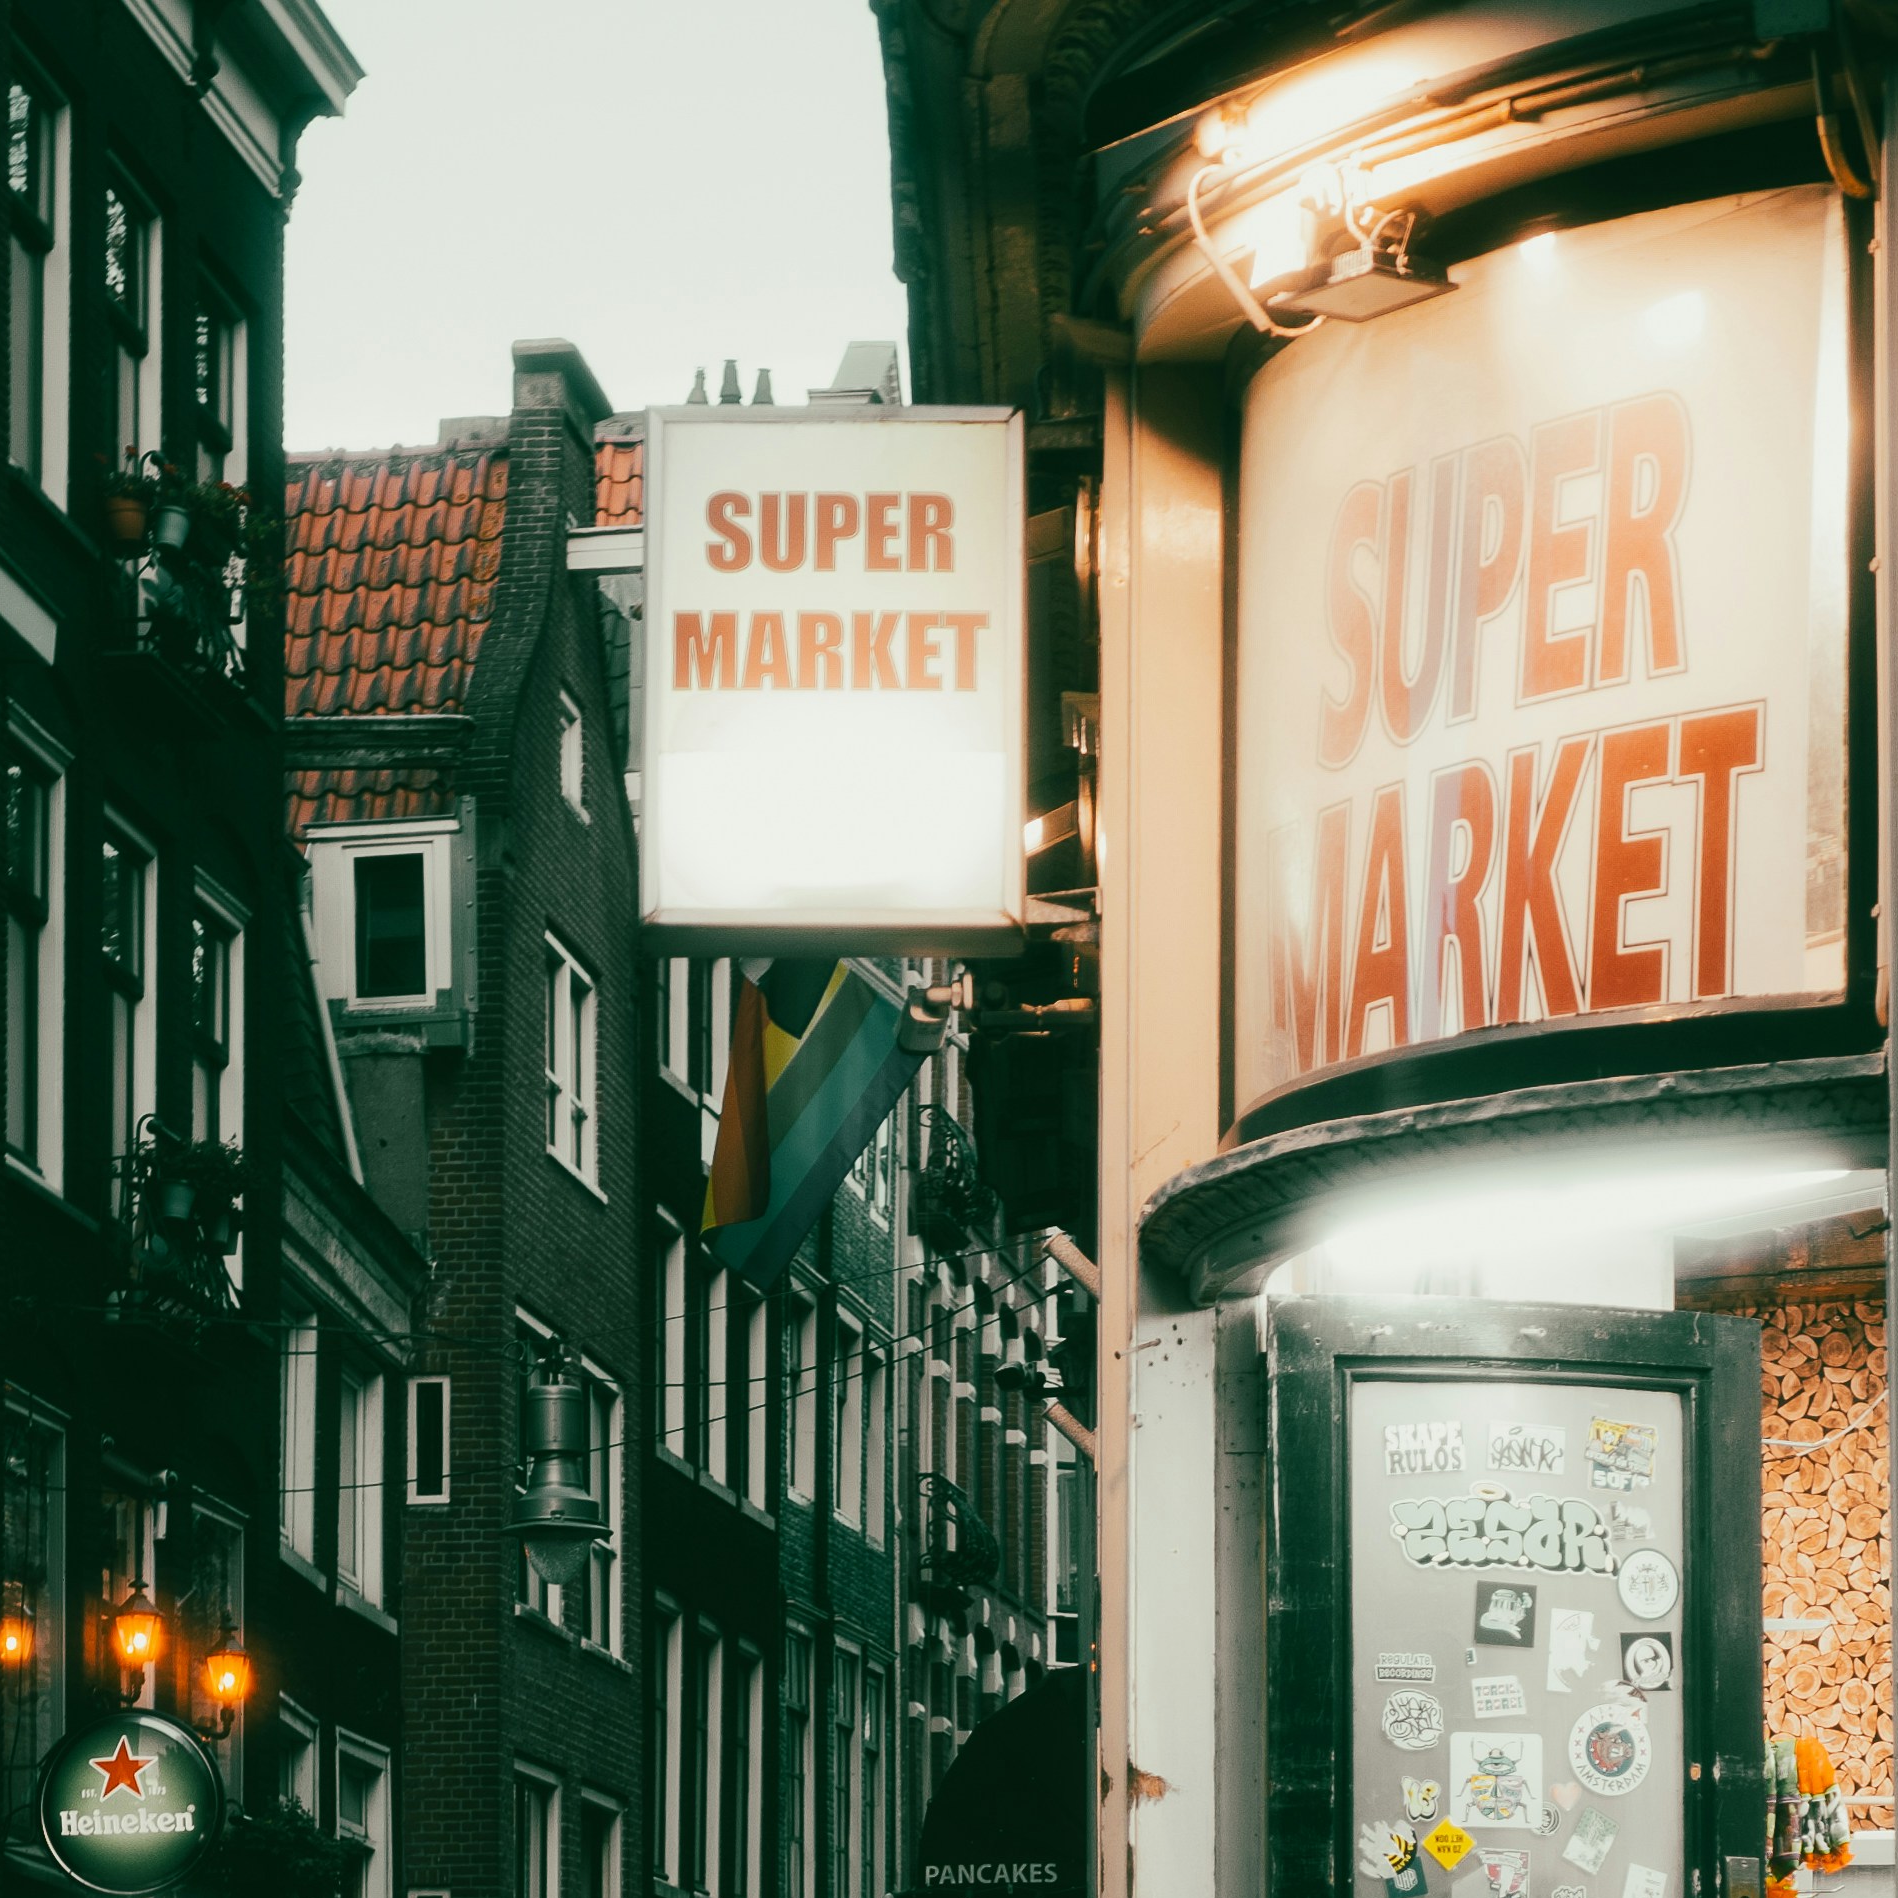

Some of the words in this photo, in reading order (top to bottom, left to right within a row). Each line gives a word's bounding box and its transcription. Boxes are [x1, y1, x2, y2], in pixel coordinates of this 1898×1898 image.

[705, 488, 956, 574] SUPER
[1316, 389, 1693, 770] SUPER
[672, 608, 990, 693] MARKET
[1268, 699, 1767, 1077] MARKET
[1575, 1762, 1647, 1791] AMSTERDAM
[60, 1803, 195, 1837] Heineken
[924, 1863, 1059, 1887] PANCAKES
